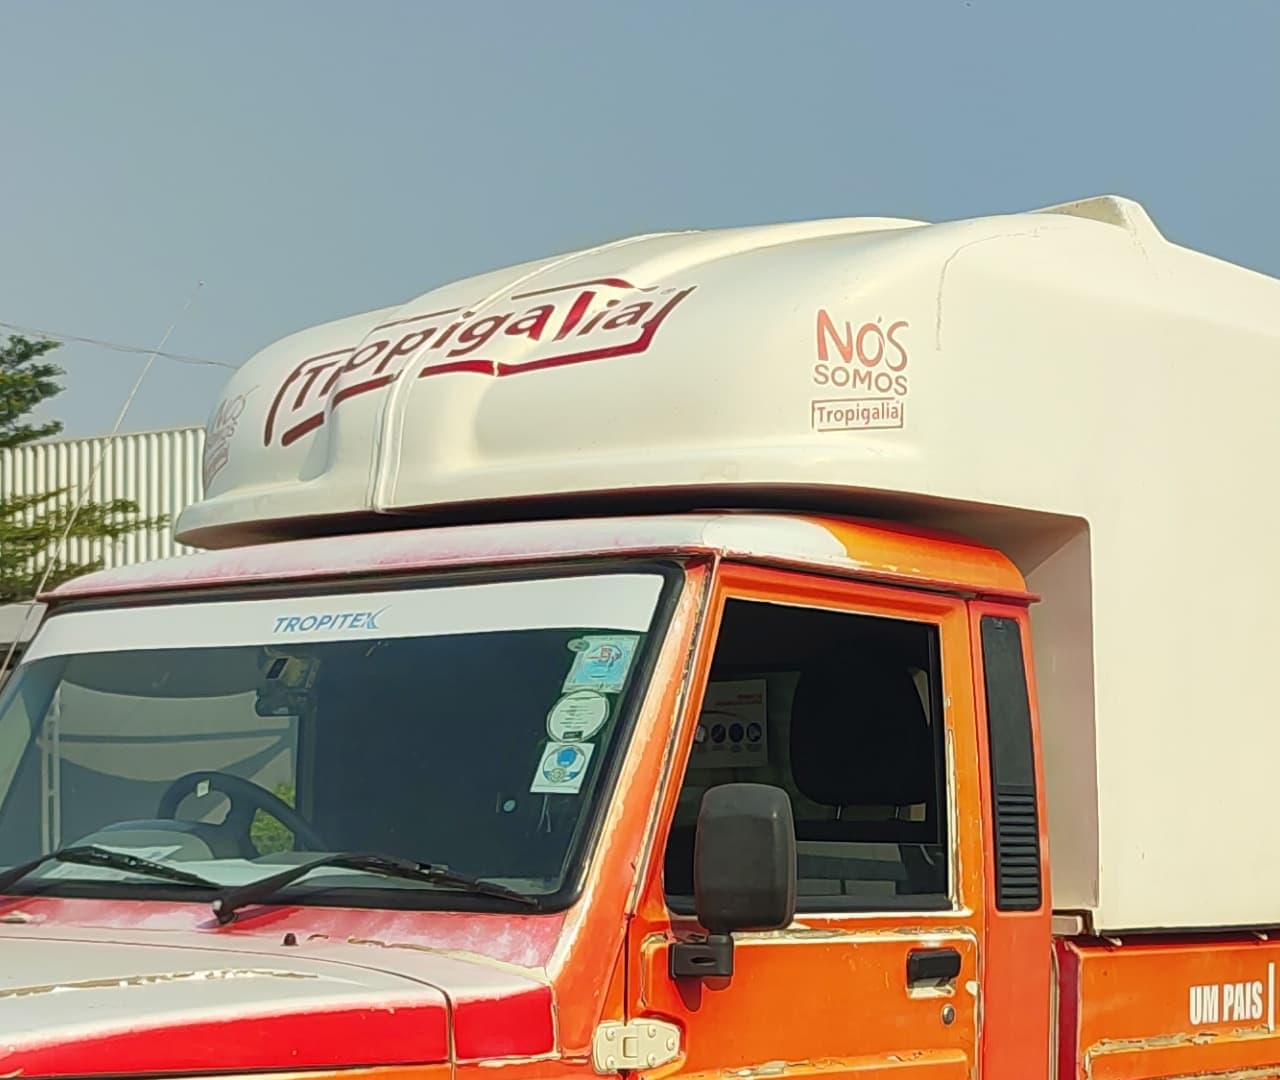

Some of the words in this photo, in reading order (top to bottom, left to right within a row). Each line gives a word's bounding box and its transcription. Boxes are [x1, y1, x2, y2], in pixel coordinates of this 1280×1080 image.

[291, 290, 654, 412] Tropigalia
[816, 308, 909, 372] NÓS
[813, 363, 908, 396] SOMOS
[816, 402, 900, 426] Tropigalia
[1189, 983, 1220, 1025] UM
[1222, 981, 1263, 1022] PAIS
